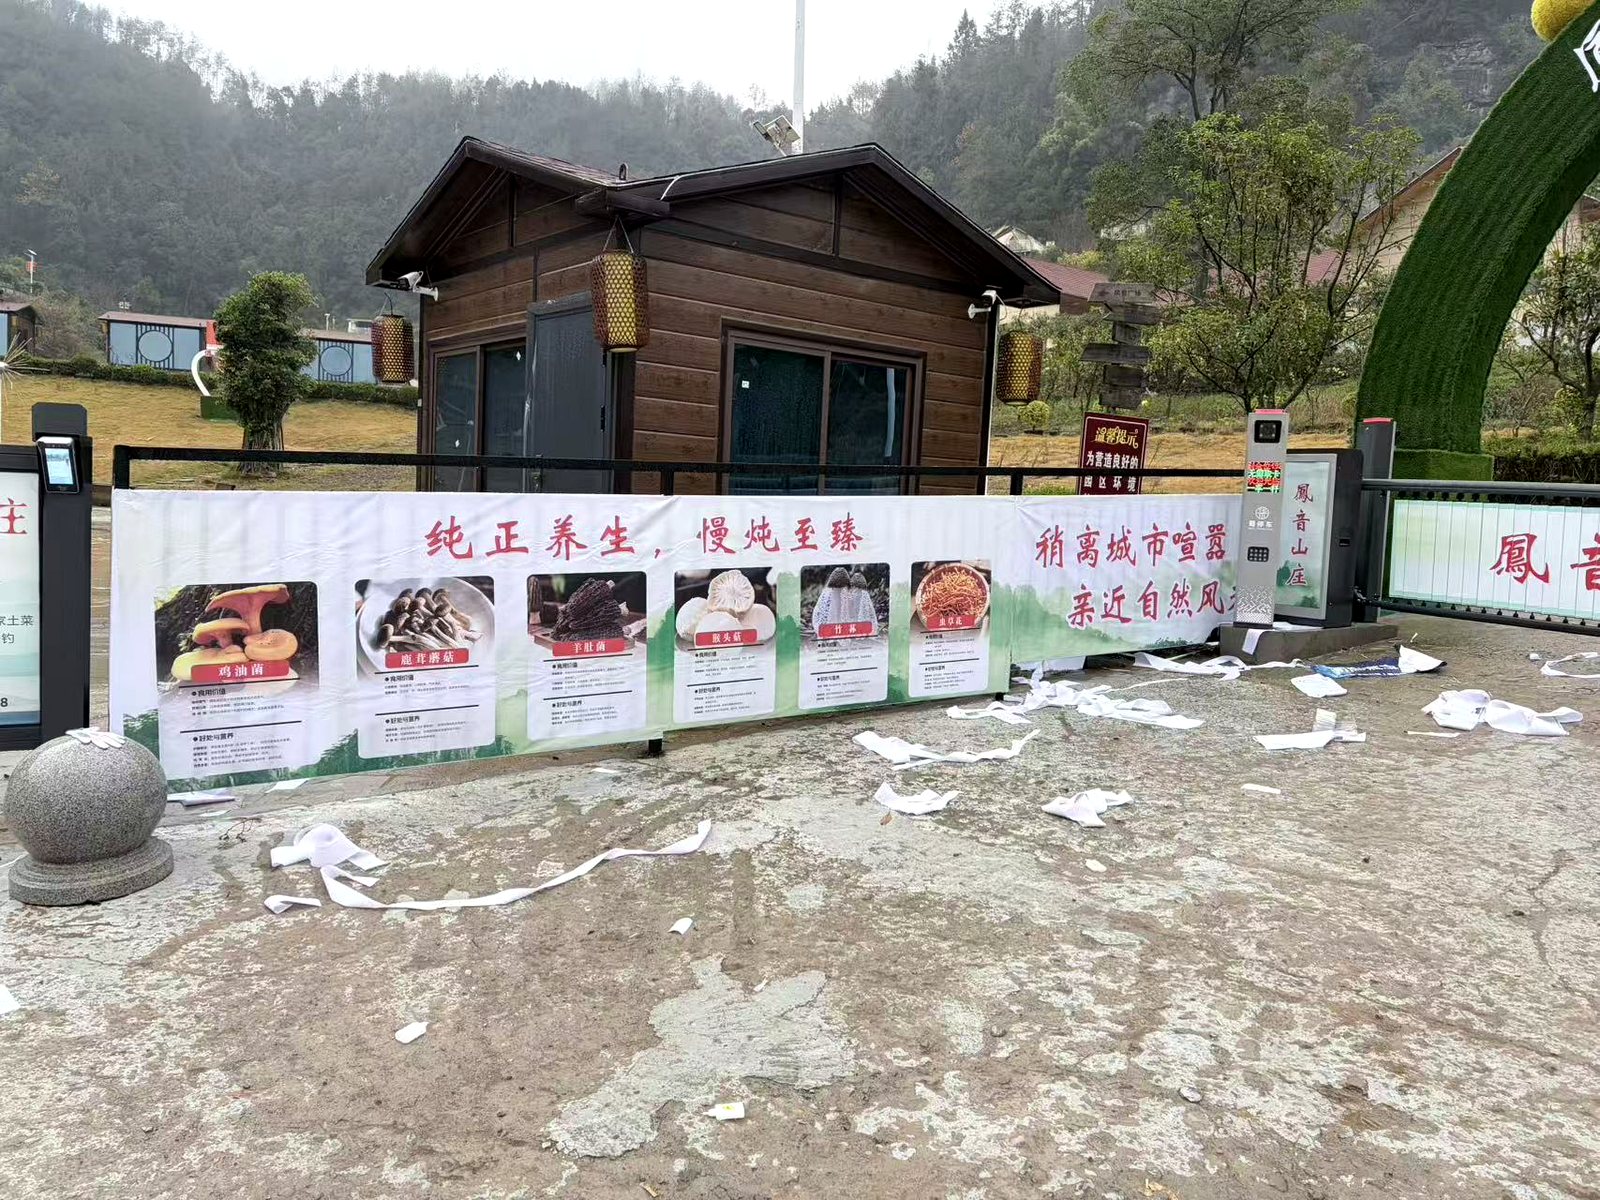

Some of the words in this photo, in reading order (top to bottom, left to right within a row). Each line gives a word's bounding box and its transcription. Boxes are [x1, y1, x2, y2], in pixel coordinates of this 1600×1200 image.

[1094, 426, 1139, 449] 温馨提示
[1086, 450, 1139, 469] 为营造良好的
[1084, 475, 1137, 492] 园区环境
[1036, 521, 1227, 569] 稍离城市喧嚣
[573, 641, 607, 654] 羊肚菌
[400, 651, 455, 666] 鹿茸蘑菇
[218, 663, 264, 678] 鸡油菌
